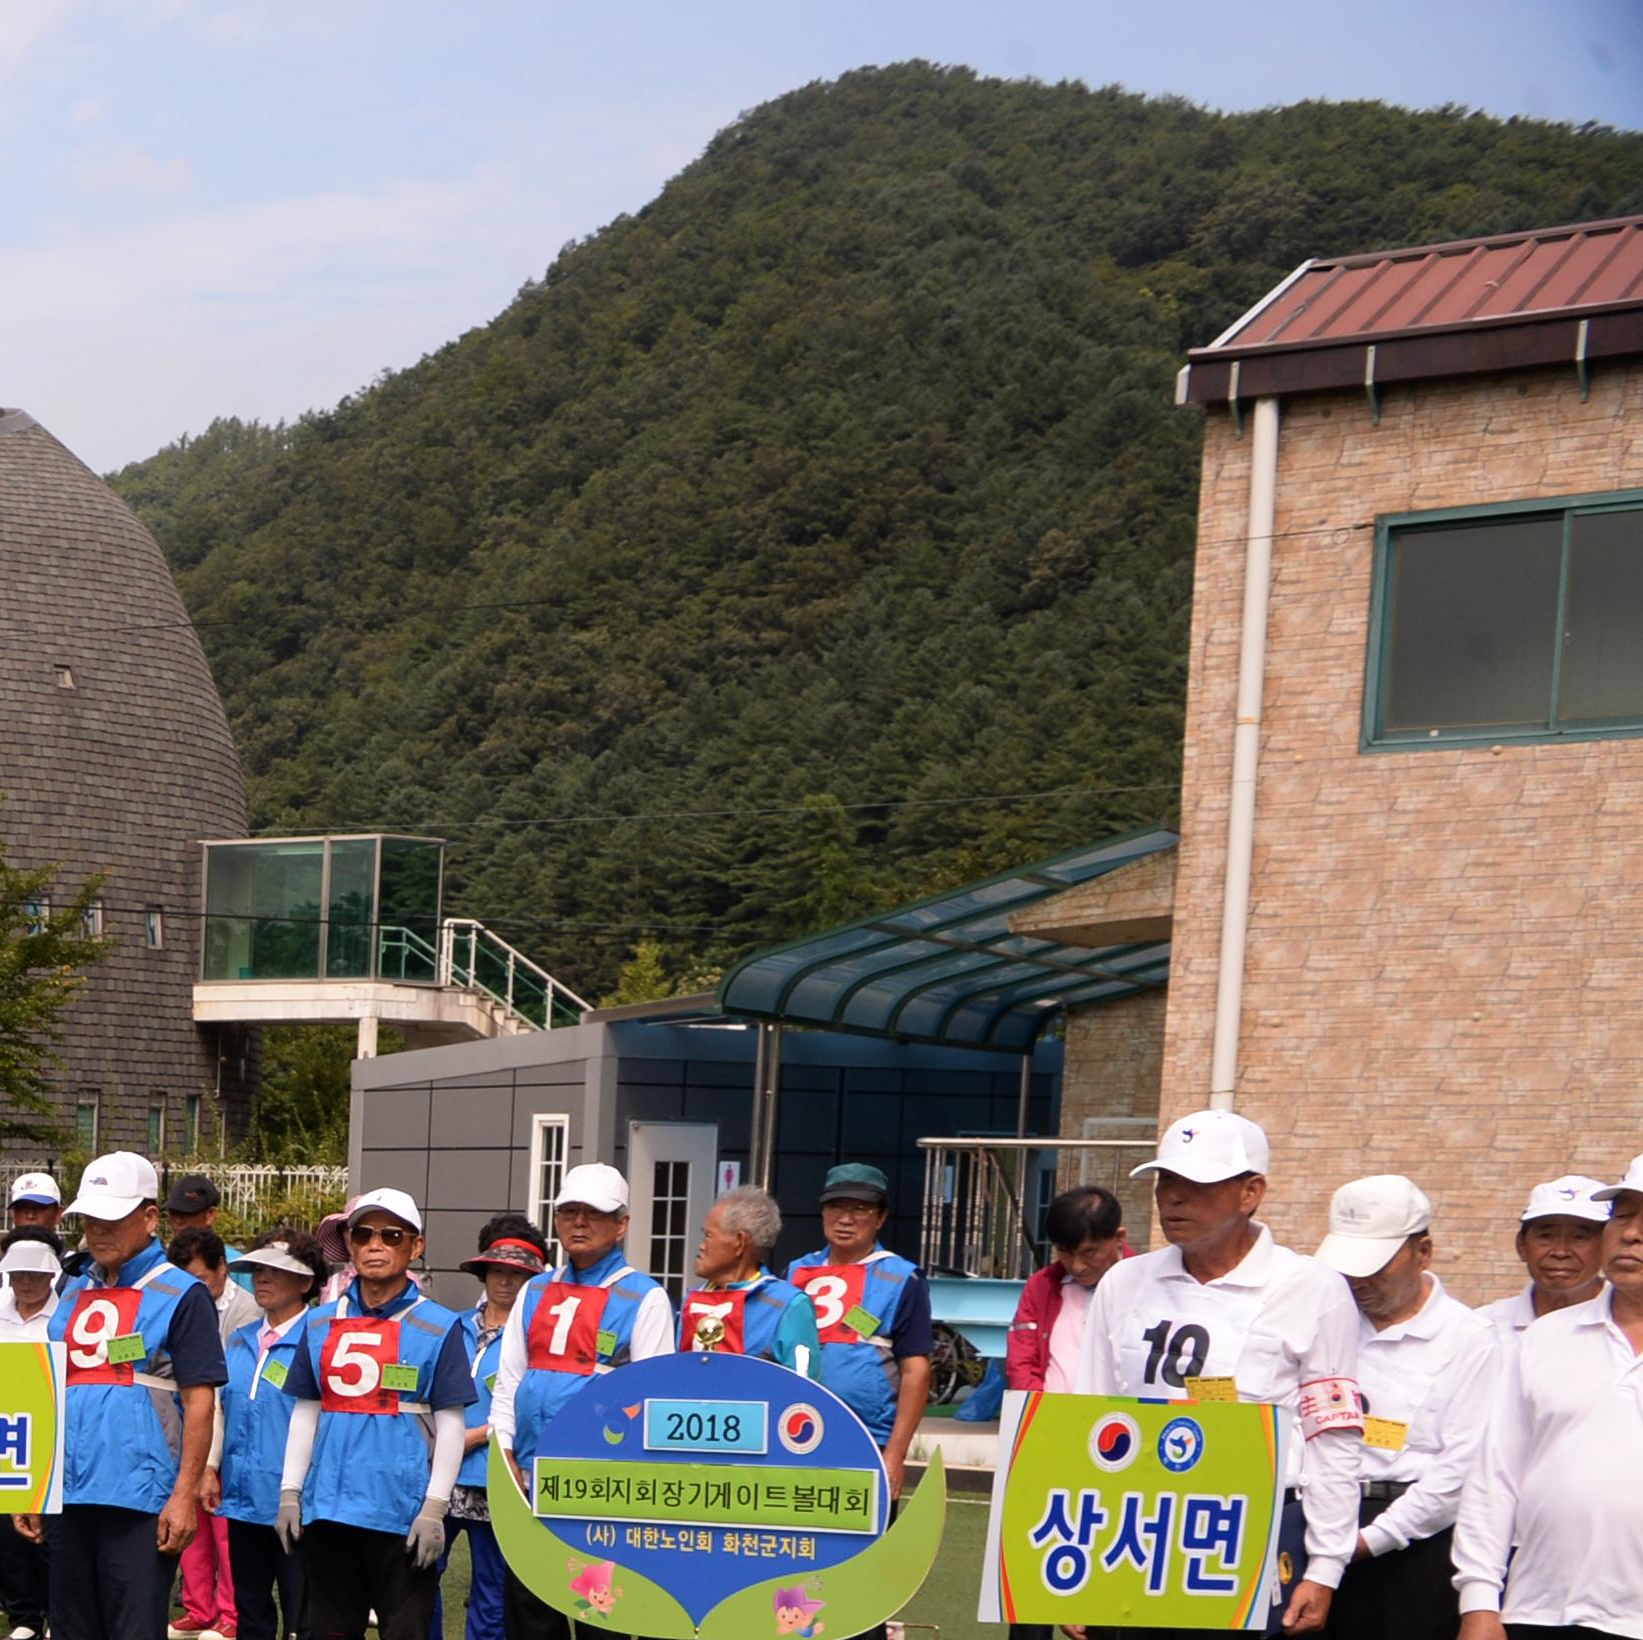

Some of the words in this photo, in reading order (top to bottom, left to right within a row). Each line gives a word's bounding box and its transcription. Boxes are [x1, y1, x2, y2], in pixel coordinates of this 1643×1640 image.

[549, 1296, 582, 1355] 1
[805, 1275, 848, 1329] 3
[70, 1299, 119, 1369] 9
[327, 1332, 382, 1397] 5
[1143, 1319, 1210, 1388] 10
[665, 1412, 742, 1443] 2018
[586, 1523, 616, 1548] (사)
[625, 1527, 713, 1553] 대한노인회
[722, 1532, 816, 1560] 화천군지회
[1032, 1492, 1245, 1592] 상서면
